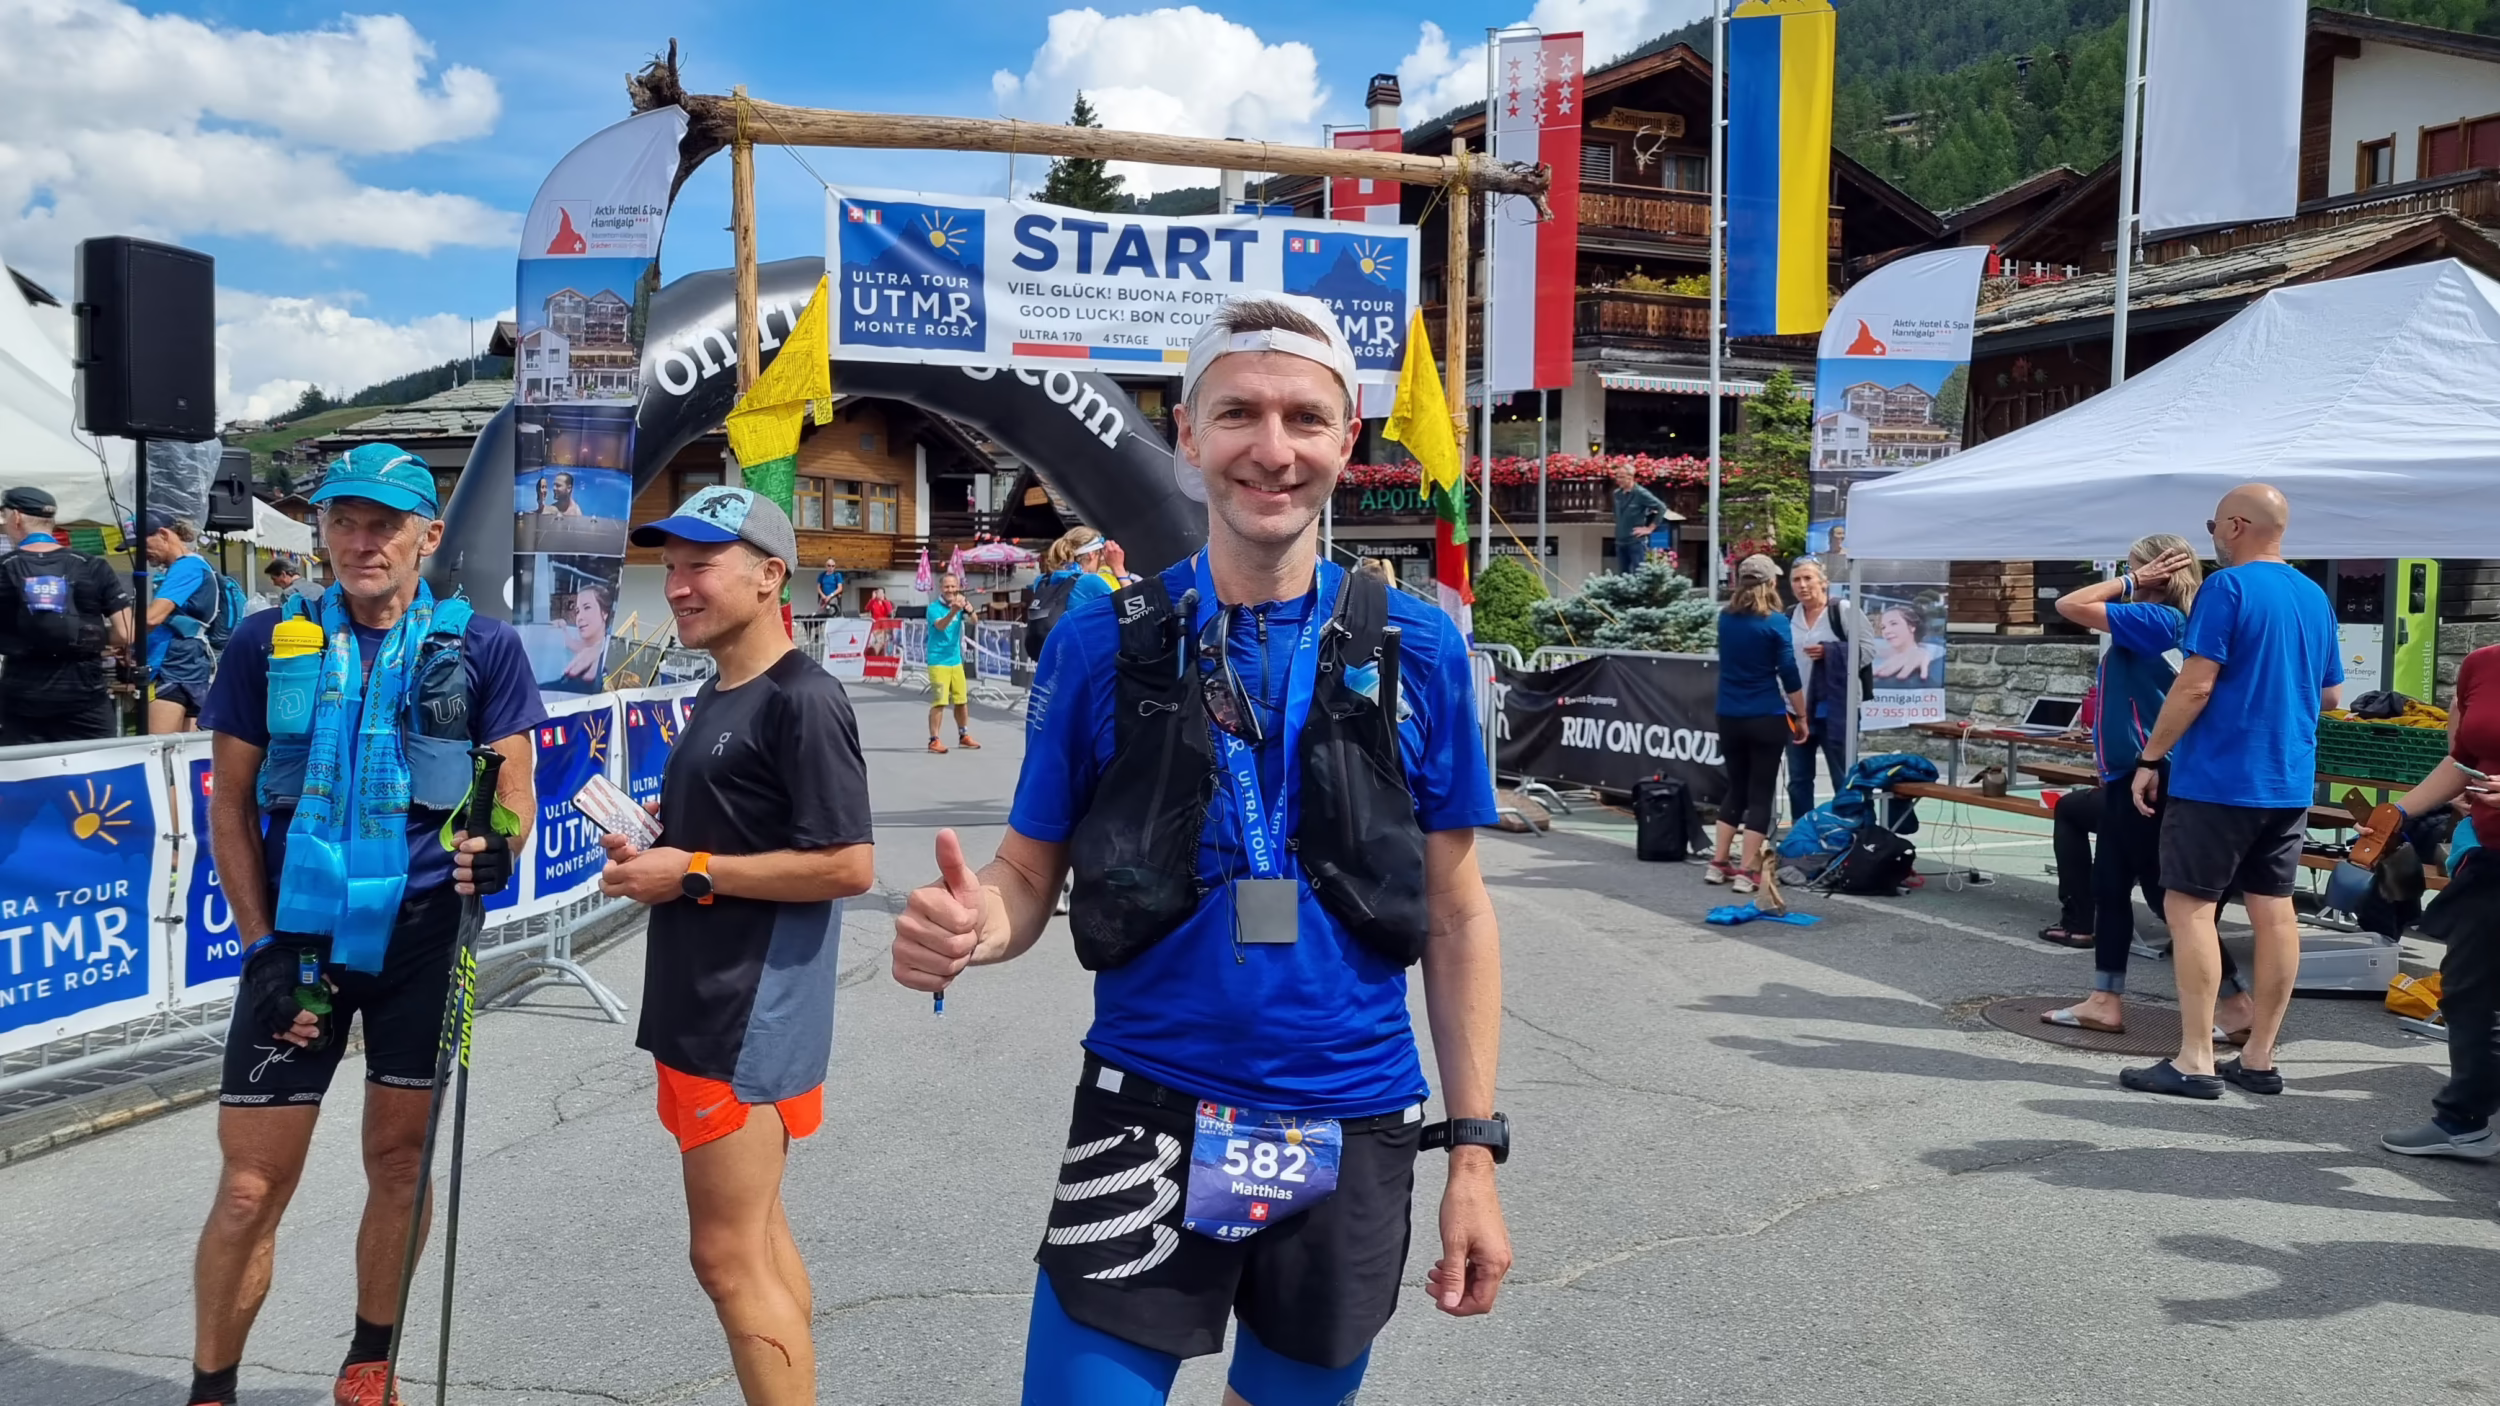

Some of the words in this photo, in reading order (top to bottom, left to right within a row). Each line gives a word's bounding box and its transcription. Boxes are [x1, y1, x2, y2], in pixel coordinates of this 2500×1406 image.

[618, 204, 641, 216] Hotel
[590, 217, 634, 229] Hannigalp
[1011, 214, 1259, 283] START
[852, 271, 911, 285] ULTRA
[921, 274, 969, 289] TOUR
[1008, 281, 1045, 296] VIEL
[1050, 282, 1112, 300] GLÜCK!
[1117, 288, 1177, 303] BUONA
[1182, 291, 1228, 305] FORT
[853, 287, 977, 328] UTMR
[1019, 304, 1071, 319] GOOD
[1076, 307, 1125, 322] LUCK!
[1130, 310, 1165, 324] BON
[1322, 298, 1345, 310] RA
[1352, 299, 1394, 312] TOUR
[854, 320, 917, 336] MONTE
[924, 324, 973, 338] ROSA
[1335, 314, 1400, 350] MR
[1892, 328, 1935, 339] Hannigalp
[1893, 319, 1917, 328] Aktiv
[1919, 319, 1942, 329] Hotel
[1952, 321, 1970, 331] Spa
[1019, 328, 1059, 341] ULTRA
[1062, 331, 1083, 342] 170
[1102, 333, 1110, 344] 4
[1112, 334, 1150, 345] STAGE
[1166, 336, 1194, 347] ULTR
[1353, 346, 1395, 358] ROSA
[1360, 486, 1473, 511] APOTHE
[1357, 543, 1418, 556] Pharmacie
[1479, 544, 1552, 555] arfumere
[32, 584, 58, 594] 595
[1299, 625, 1312, 650] 170
[2343, 667, 2377, 677] aturEnergie
[2421, 640, 2432, 700] ankstelle
[1871, 694, 1938, 705] annigalp.ch
[1883, 708, 1904, 717] 955
[1561, 716, 1606, 750] RUN
[1606, 720, 1644, 754] ON
[632, 777, 659, 792] ULTRA
[544, 799, 576, 820] ULT
[1250, 826, 1270, 873] TOUR
[545, 851, 584, 881] MONTE
[56, 879, 129, 908] TOUR
[0, 906, 138, 975] TMR
[0, 977, 53, 1008] NTE
[64, 962, 132, 990] ROSA
[460, 951, 477, 1069] DYNAFIT
[1222, 1138, 1307, 1183] 582
[1231, 1181, 1293, 1200] Matthias
[1217, 1225, 1228, 1237] 4
[1229, 1226, 1258, 1238] STA
